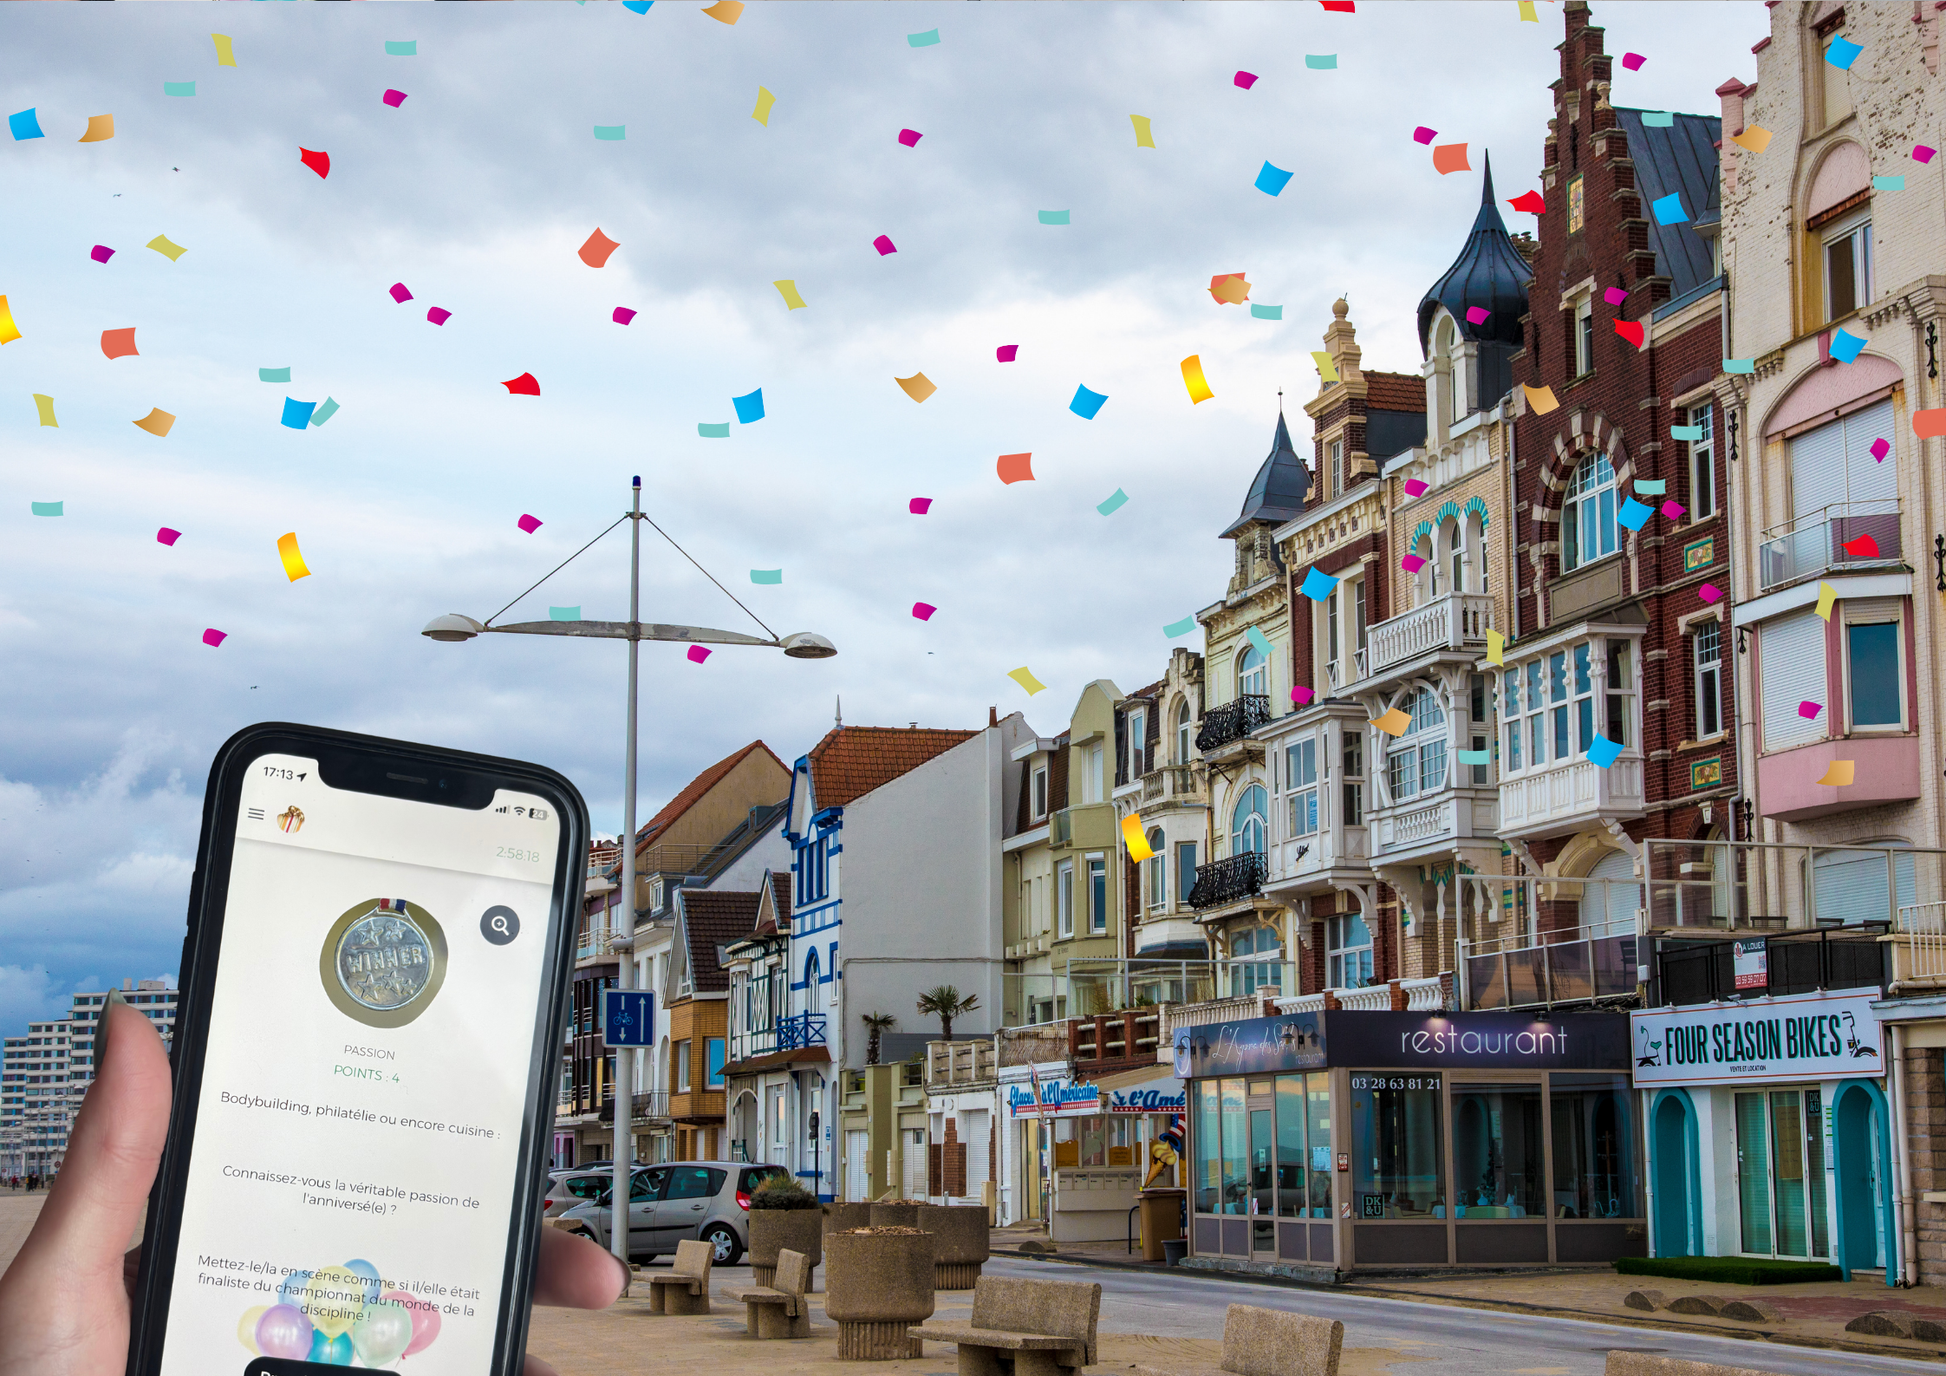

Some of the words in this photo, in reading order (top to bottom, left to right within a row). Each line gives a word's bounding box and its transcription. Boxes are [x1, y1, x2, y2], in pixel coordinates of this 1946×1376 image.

[263, 766, 294, 780] 17:13
[532, 810, 544, 819] 24
[496, 846, 540, 863] 2:58:18
[1747, 941, 1766, 950] LOUER
[346, 945, 423, 973] WINNER
[1401, 1024, 1568, 1054] restaurant
[1665, 1025, 1709, 1066] FOUR
[1712, 1018, 1782, 1063] SEASON
[1785, 1014, 1843, 1059] BIKES
[344, 1044, 396, 1060] PASSION
[1295, 1053, 1324, 1065] restaurant
[334, 1065, 382, 1081] POINTS
[391, 1073, 400, 1084] 4
[1352, 1078, 1367, 1089] 03
[1371, 1078, 1386, 1089] 28
[1389, 1078, 1404, 1089] 63
[1408, 1078, 1422, 1089] 81
[1427, 1078, 1440, 1089] 21
[1010, 1085, 1035, 1117] Glaces
[1809, 1093, 1819, 1101] DK
[221, 1091, 312, 1115] Bodybuilding,
[315, 1105, 376, 1122] philatélie
[380, 1115, 397, 1125] ou
[400, 1118, 445, 1131] encore
[448, 1124, 494, 1138] cuisine
[222, 1165, 331, 1189] Connaissez-vous
[335, 1179, 346, 1191] la
[350, 1182, 406, 1199] véritable
[409, 1191, 459, 1206] passion
[462, 1196, 480, 1209] de
[302, 1192, 387, 1215] l'anniversé(e)
[390, 1204, 397, 1215] ?
[1366, 1197, 1381, 1205] DK
[1366, 1206, 1381, 1215] &U
[198, 1255, 277, 1275] Mettez-le/la
[281, 1266, 298, 1277] en
[301, 1269, 340, 1283] scène
[343, 1274, 395, 1289] comme
[398, 1280, 409, 1291] si
[412, 1280, 447, 1296] il/elle
[450, 1286, 480, 1300] était
[198, 1272, 250, 1289] finaliste
[254, 1279, 272, 1292] du
[275, 1283, 366, 1304] championnat
[369, 1294, 387, 1306] du
[391, 1298, 439, 1312] monde
[443, 1303, 460, 1315] de
[463, 1305, 475, 1317] la
[300, 1303, 364, 1321] discipline
